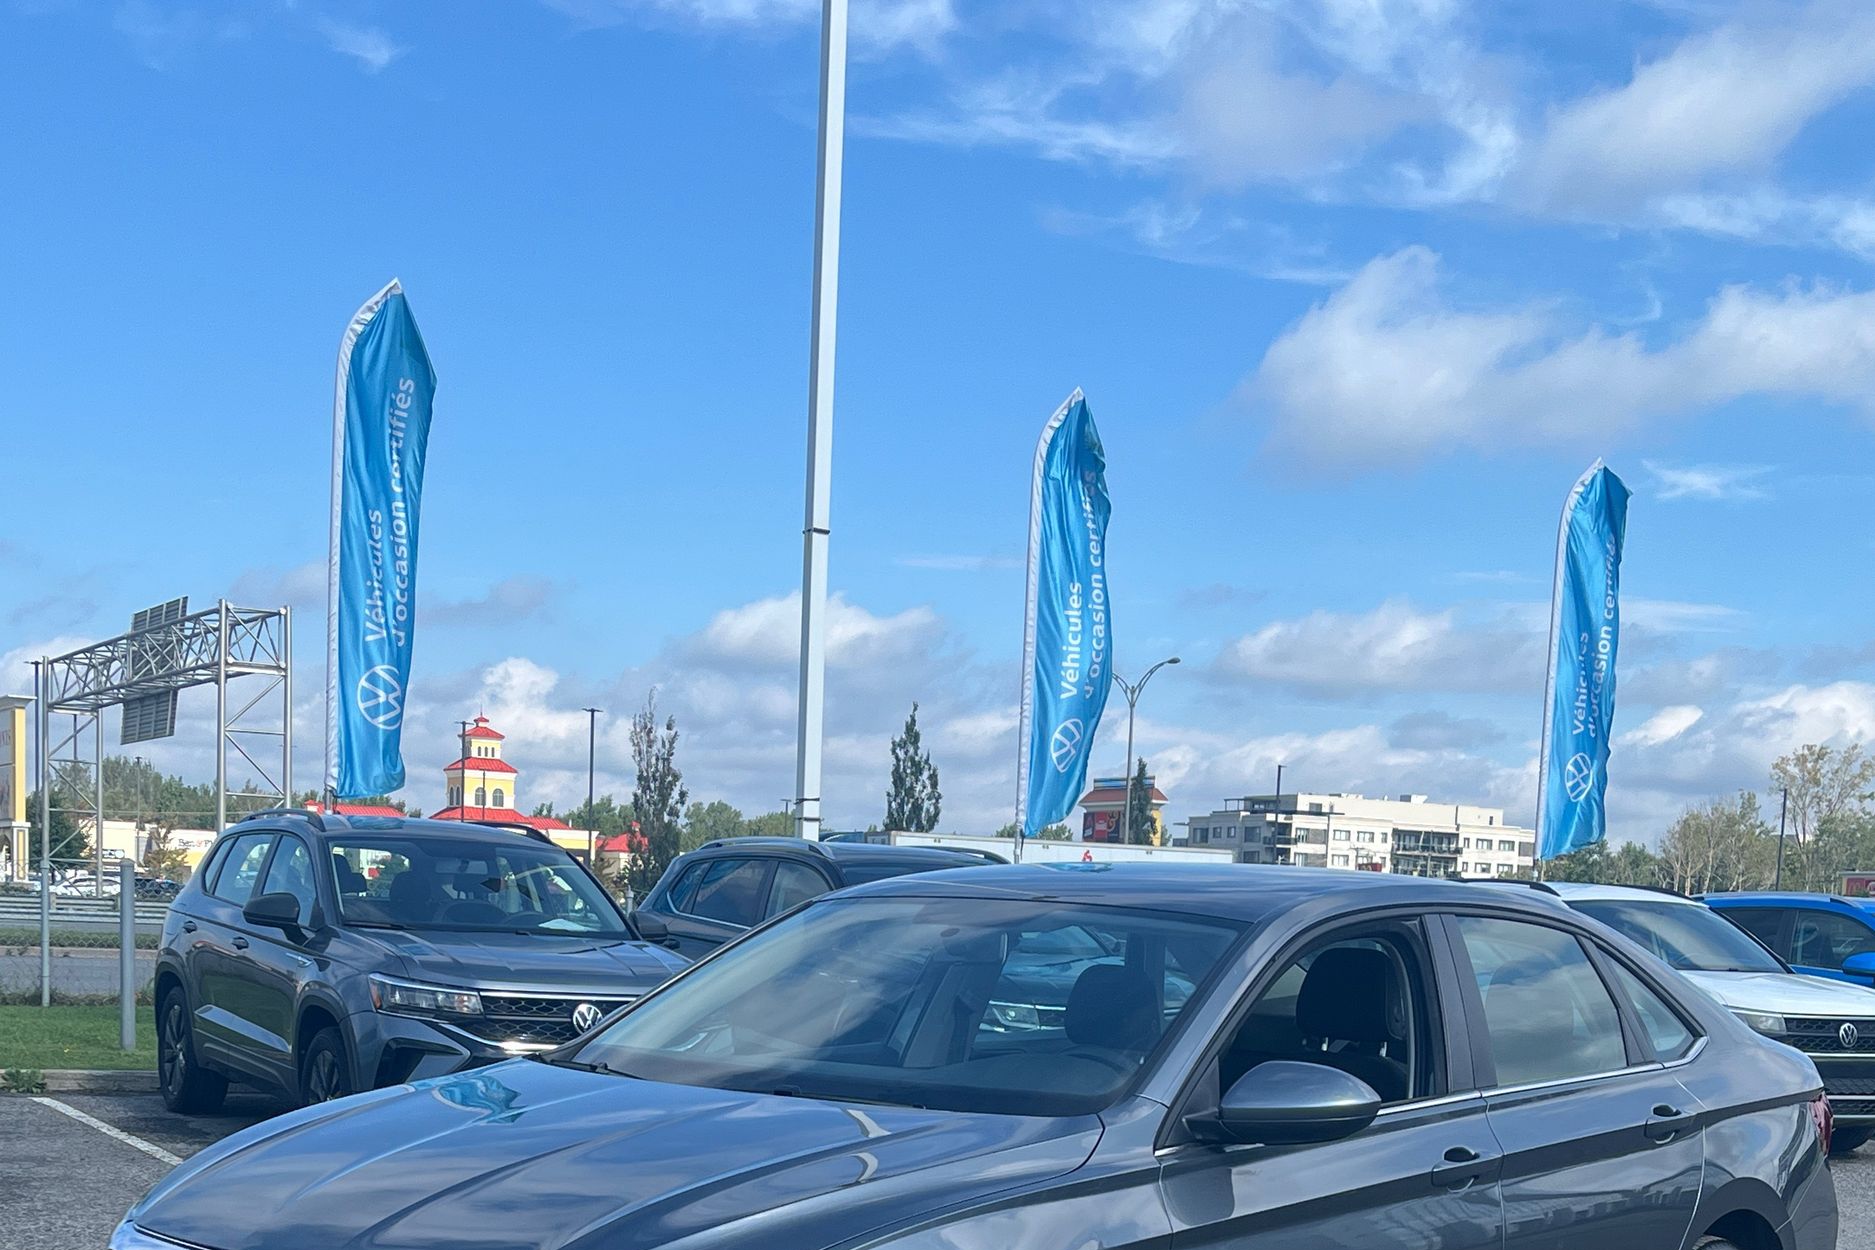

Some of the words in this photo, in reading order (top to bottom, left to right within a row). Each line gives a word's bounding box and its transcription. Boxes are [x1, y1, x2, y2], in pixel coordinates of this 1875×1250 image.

[388, 378, 415, 493] certifiés
[364, 509, 386, 642] Véhicules
[1060, 581, 1082, 700] Véhicules
